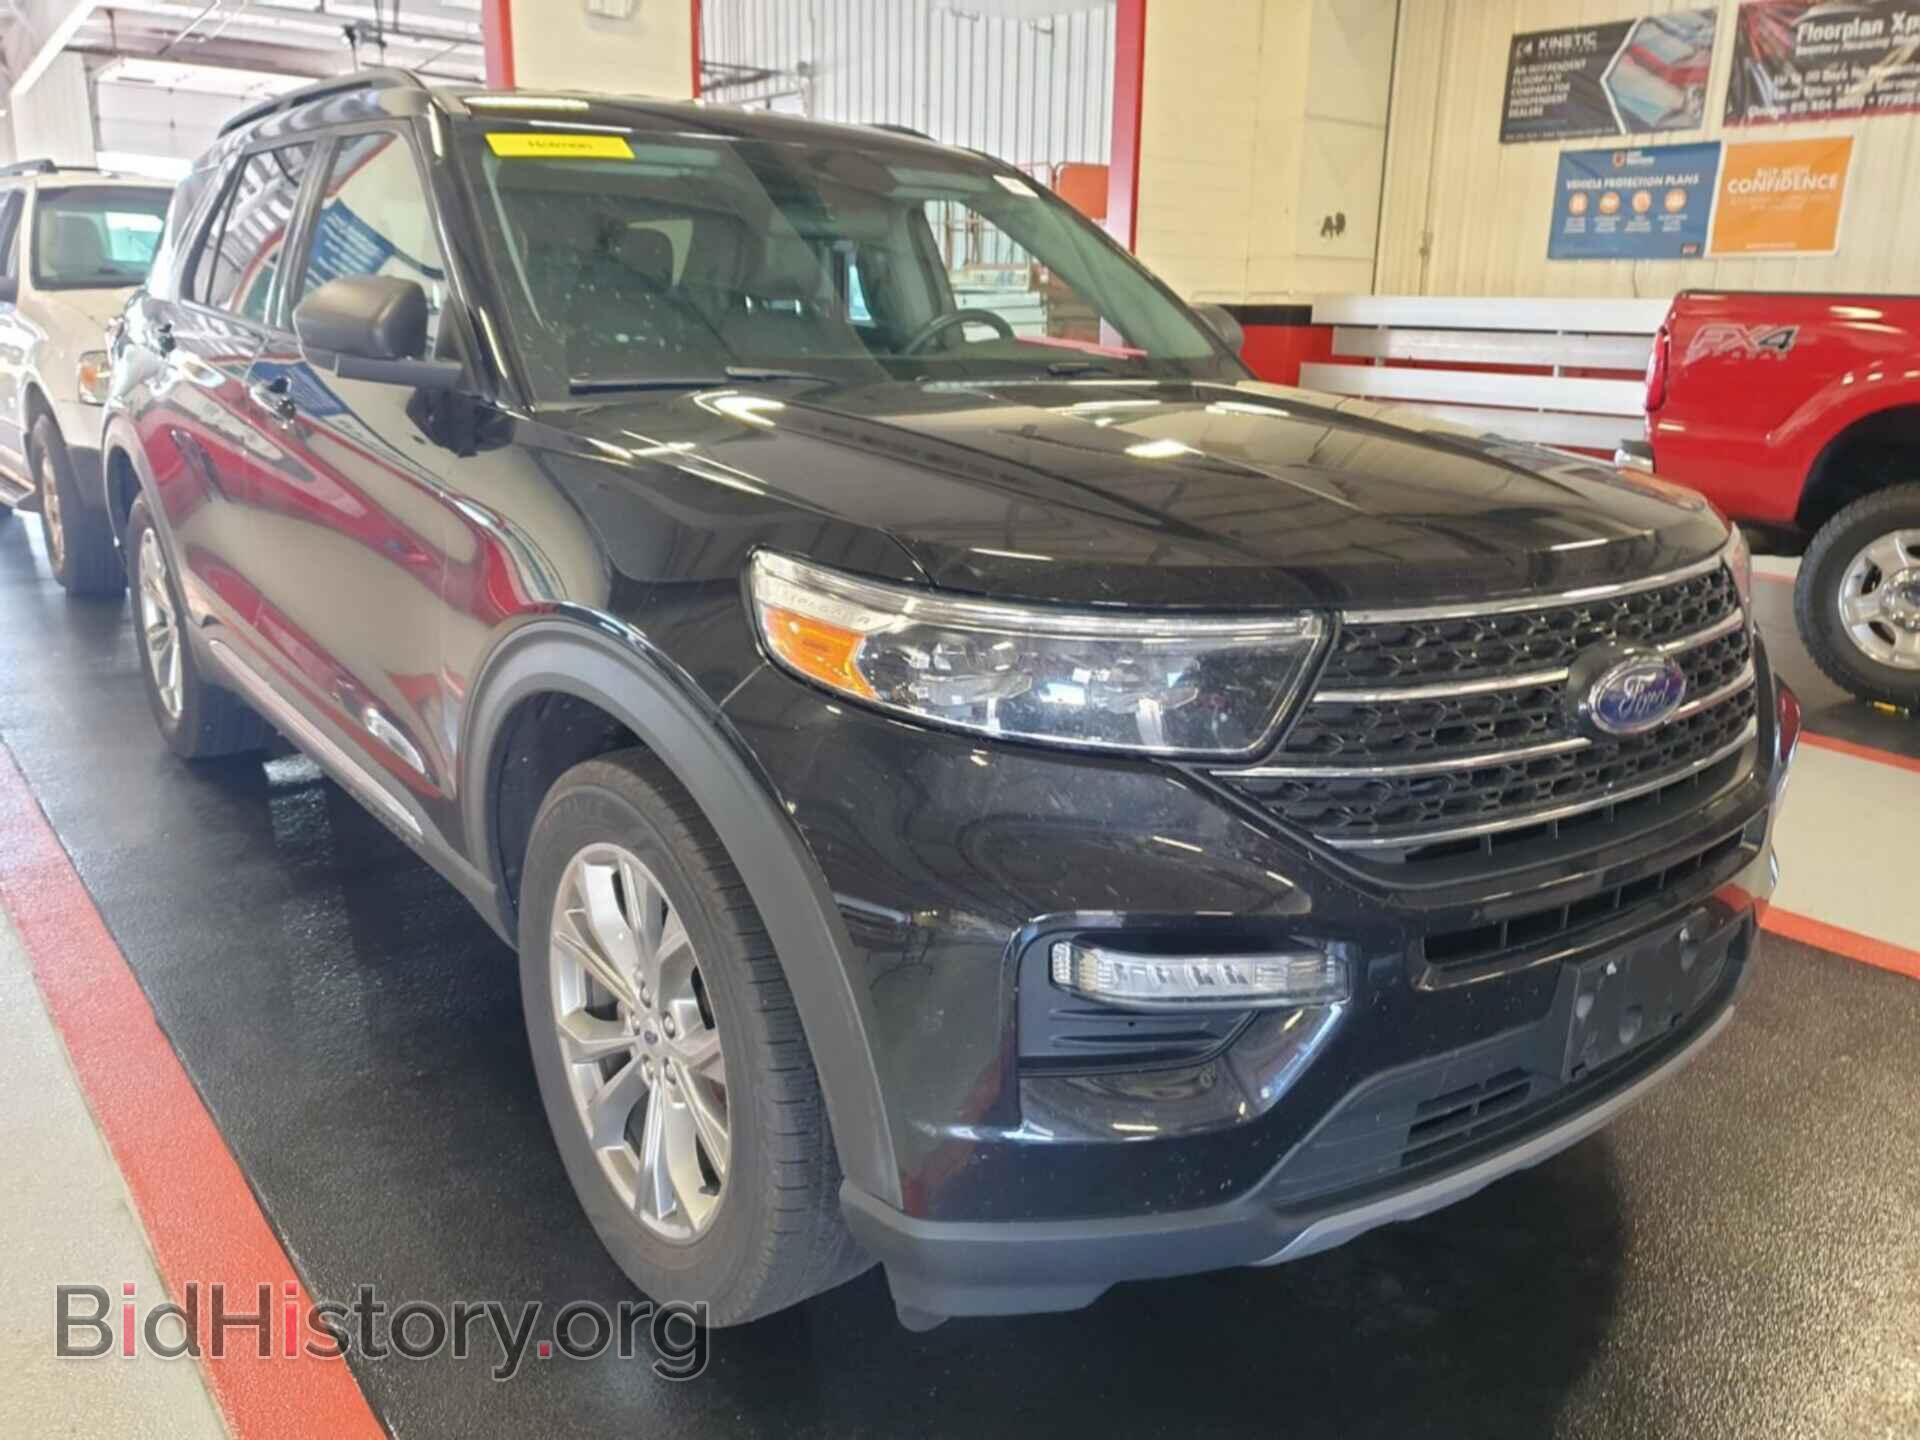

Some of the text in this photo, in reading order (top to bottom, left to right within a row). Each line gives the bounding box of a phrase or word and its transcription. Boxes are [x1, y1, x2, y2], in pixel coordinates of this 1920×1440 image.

[1538, 31, 1597, 49] KINETIC
[1566, 173, 1699, 190] VEHICLE PROTECTION PLANS
[1727, 173, 1838, 194] CONFIDENCE
[1682, 323, 1800, 366] FX4
